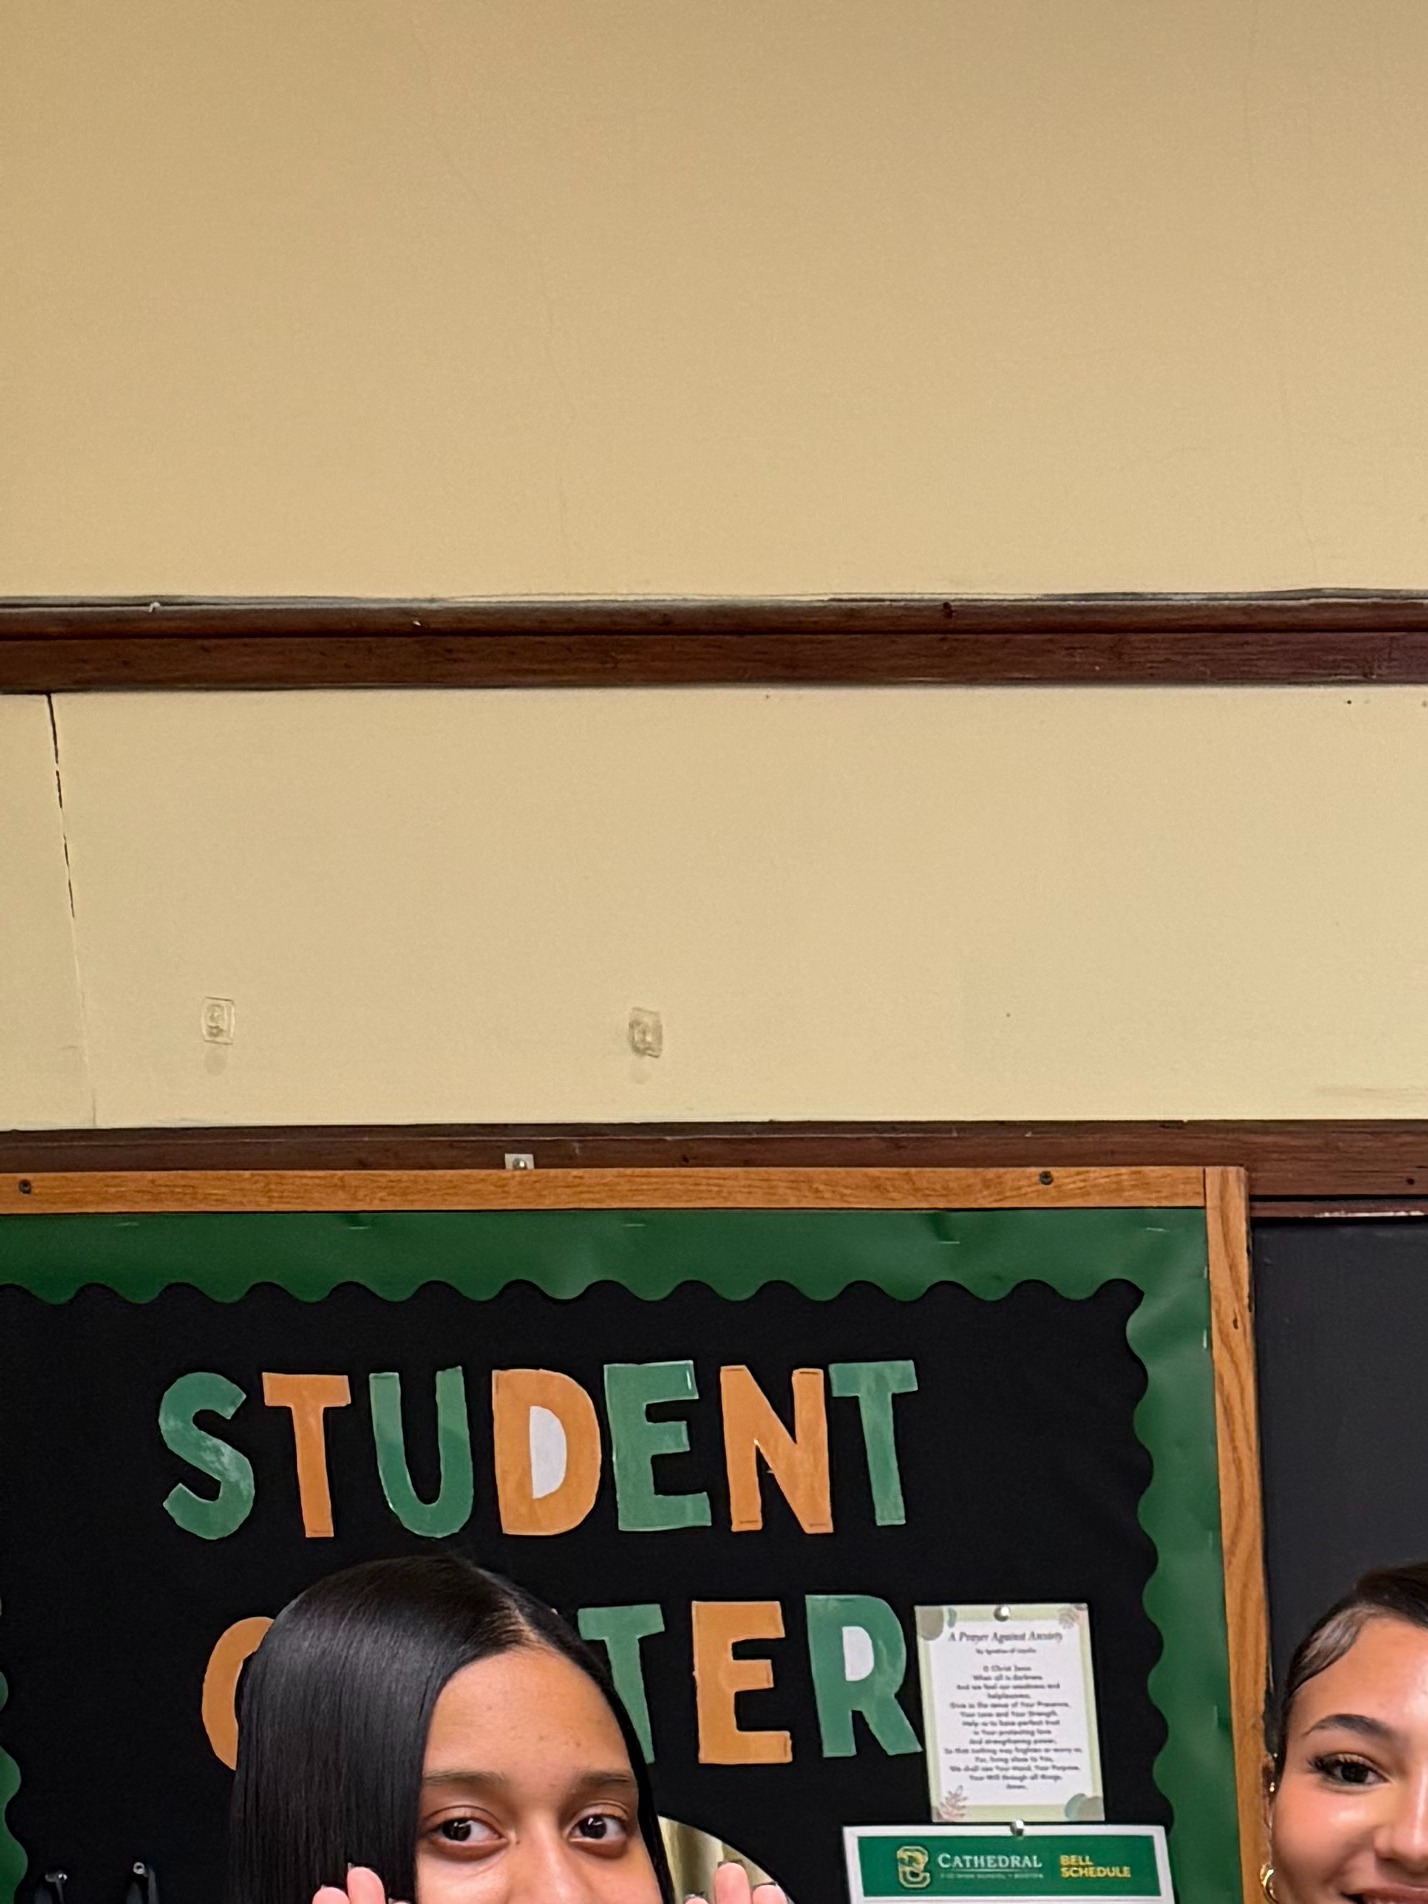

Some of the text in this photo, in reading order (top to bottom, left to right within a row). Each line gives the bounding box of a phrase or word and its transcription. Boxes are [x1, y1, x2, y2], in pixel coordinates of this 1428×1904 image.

[157, 1359, 918, 1541] STUDENT
[200, 1594, 923, 1772] CTER
[1059, 1854, 1094, 1866] BELL
[1060, 1866, 1131, 1878] SCHEDULE
